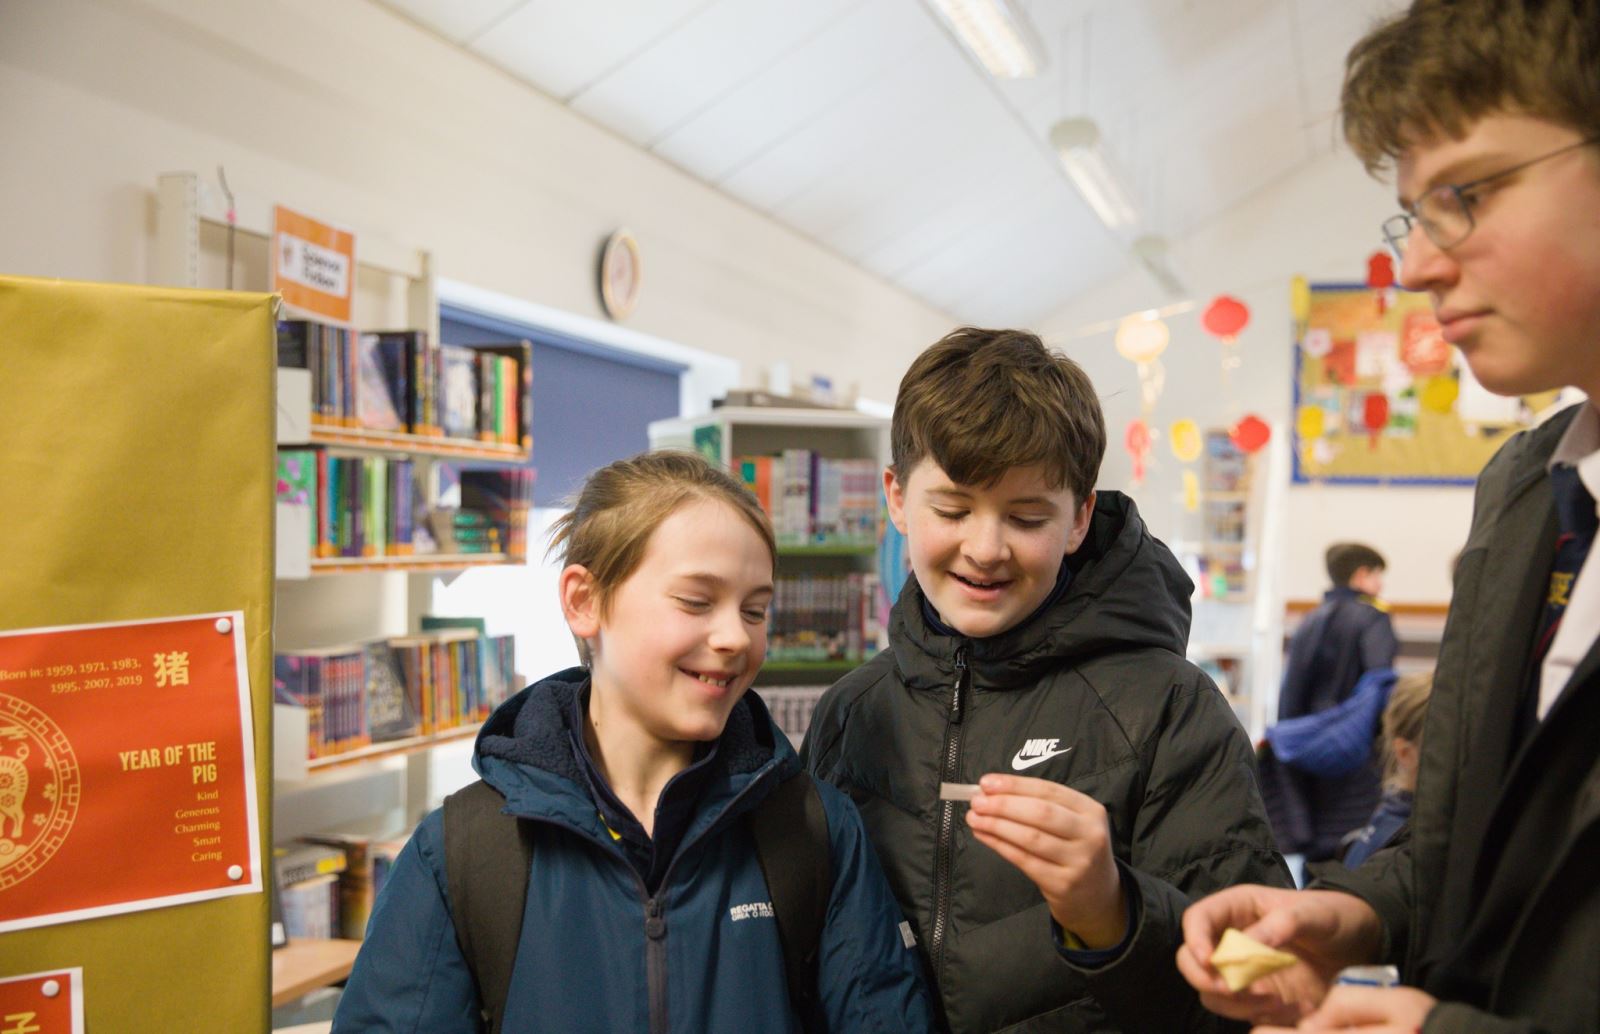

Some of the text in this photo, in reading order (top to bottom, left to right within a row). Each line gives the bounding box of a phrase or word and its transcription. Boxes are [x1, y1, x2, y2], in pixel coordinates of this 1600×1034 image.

[153, 651, 190, 688] 猪
[116, 674, 143, 687] 2019
[1020, 738, 1060, 757] NIKE
[119, 741, 217, 771] YEAR OF THE
[192, 763, 218, 784] PIG
[197, 789, 219, 801] Kind
[175, 806, 220, 819] Generous
[174, 821, 221, 834] Charming
[193, 836, 221, 847] Smart
[191, 851, 223, 862] Caring
